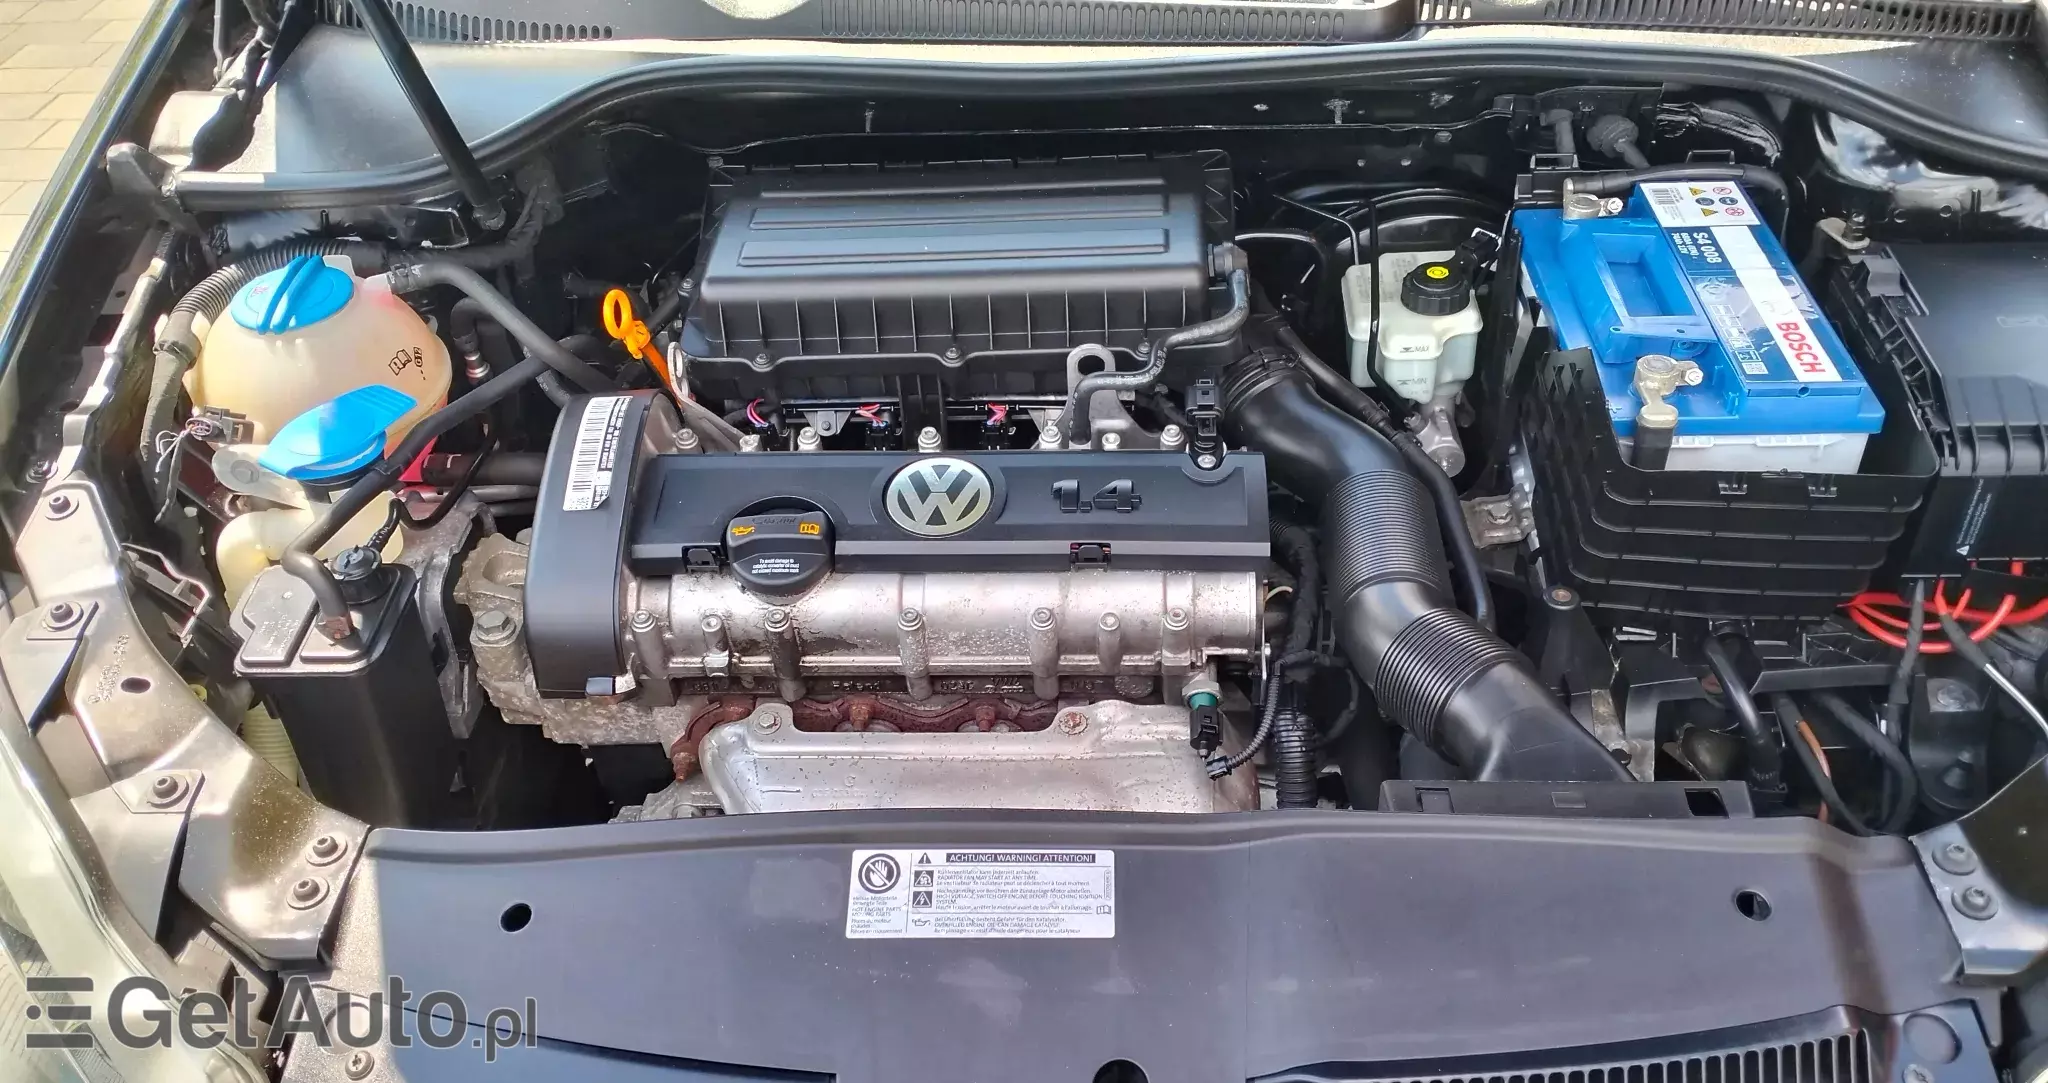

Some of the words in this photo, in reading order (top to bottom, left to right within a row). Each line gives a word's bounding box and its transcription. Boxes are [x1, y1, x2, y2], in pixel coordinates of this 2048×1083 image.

[1692, 232, 1712, 244] S4
[1701, 246, 1722, 264] 008
[1776, 322, 1826, 374] BOSCH
[1052, 479, 1142, 513] 1.4
[950, 854, 994, 862] ACHTUNG!
[997, 854, 1041, 862] WARNING!
[1042, 854, 1092, 862] ATTENTION!
